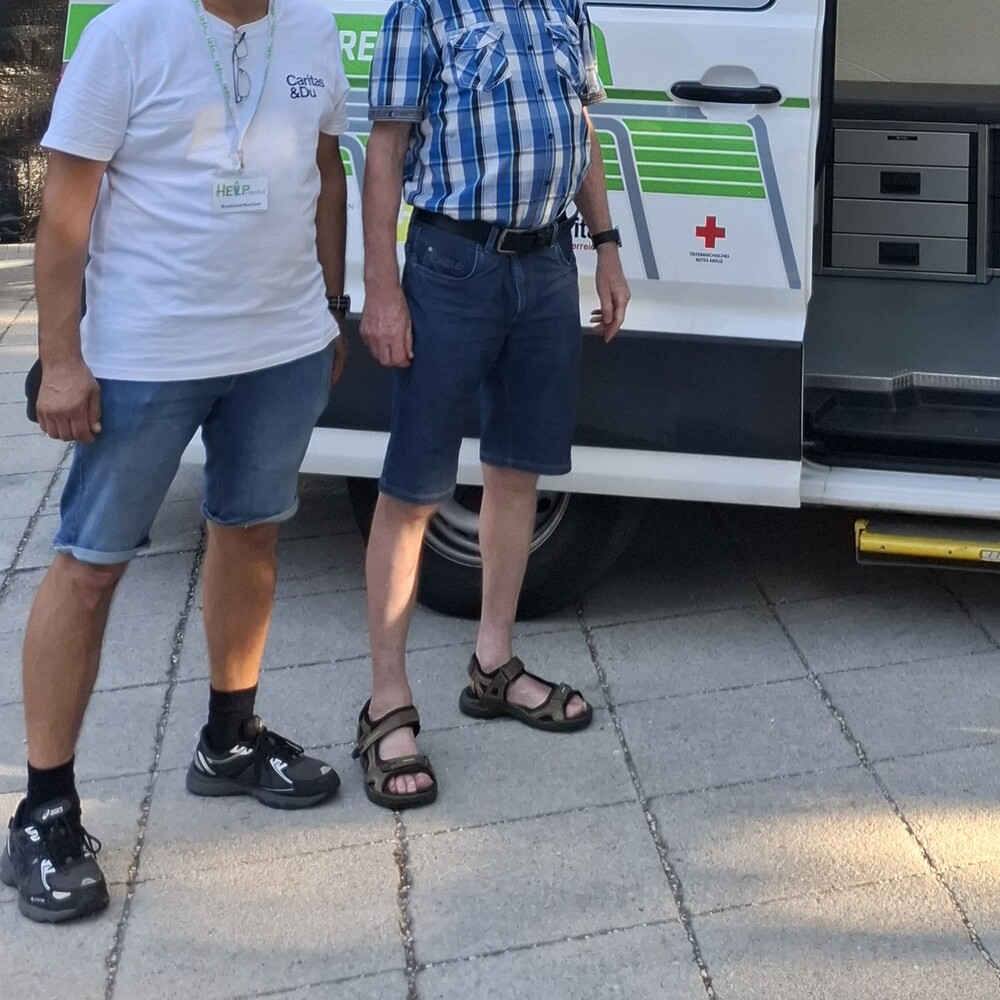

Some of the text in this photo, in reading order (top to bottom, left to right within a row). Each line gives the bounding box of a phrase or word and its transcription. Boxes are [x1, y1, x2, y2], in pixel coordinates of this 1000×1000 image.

[286, 74, 325, 88] Caritas
[290, 86, 317, 99] &Du
[216, 181, 251, 198] HELP
